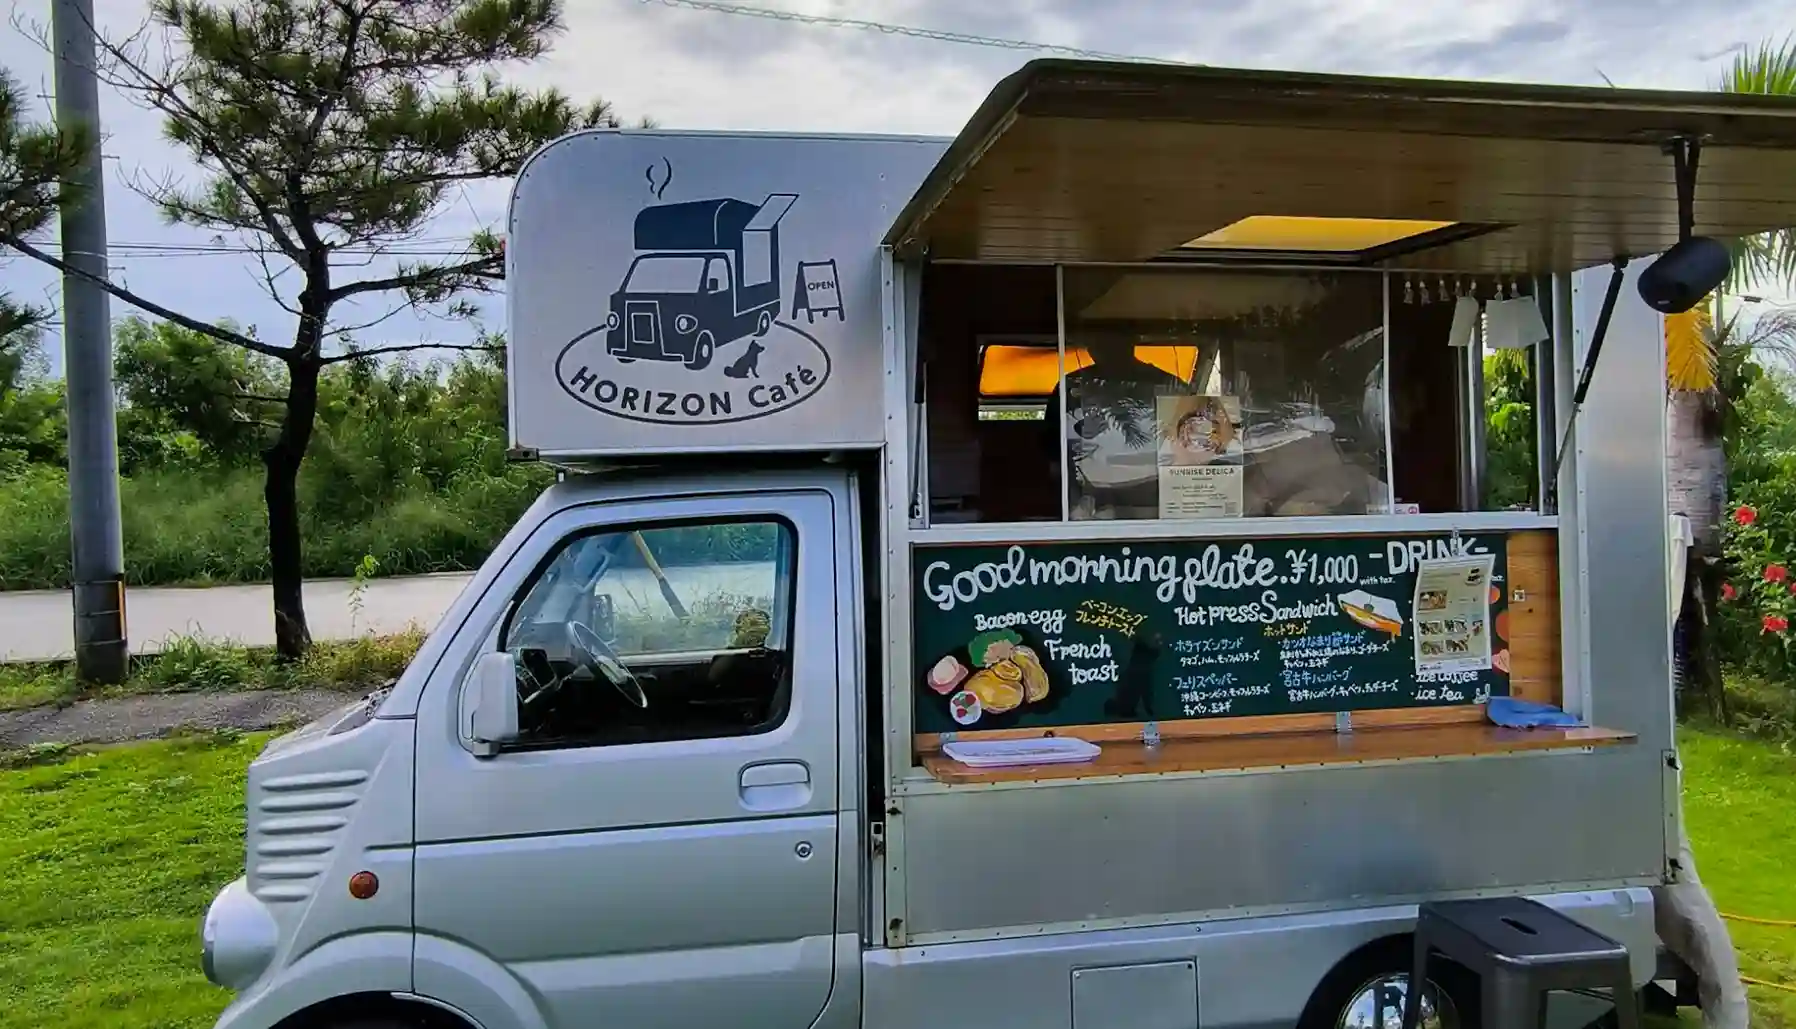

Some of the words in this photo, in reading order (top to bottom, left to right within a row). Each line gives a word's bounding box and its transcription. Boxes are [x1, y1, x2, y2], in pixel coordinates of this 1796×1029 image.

[807, 281, 835, 291] OPEN
[570, 366, 732, 416] HORIZON
[748, 364, 817, 408] Café
[923, 545, 1025, 611] Good
[1029, 546, 1182, 603] morning
[1285, 548, 1358, 585] ¥1,000
[1081, 599, 1149, 626] ベーコンエッグ
[1174, 606, 1207, 626] Hot
[1208, 603, 1262, 626] press
[1261, 589, 1339, 624] Sandwich
[1075, 610, 1136, 638] フレンチトースト
[1044, 634, 1113, 661] French
[1067, 662, 1120, 685] toast
[1415, 684, 1437, 700] ice
[1439, 684, 1465, 702] tea
